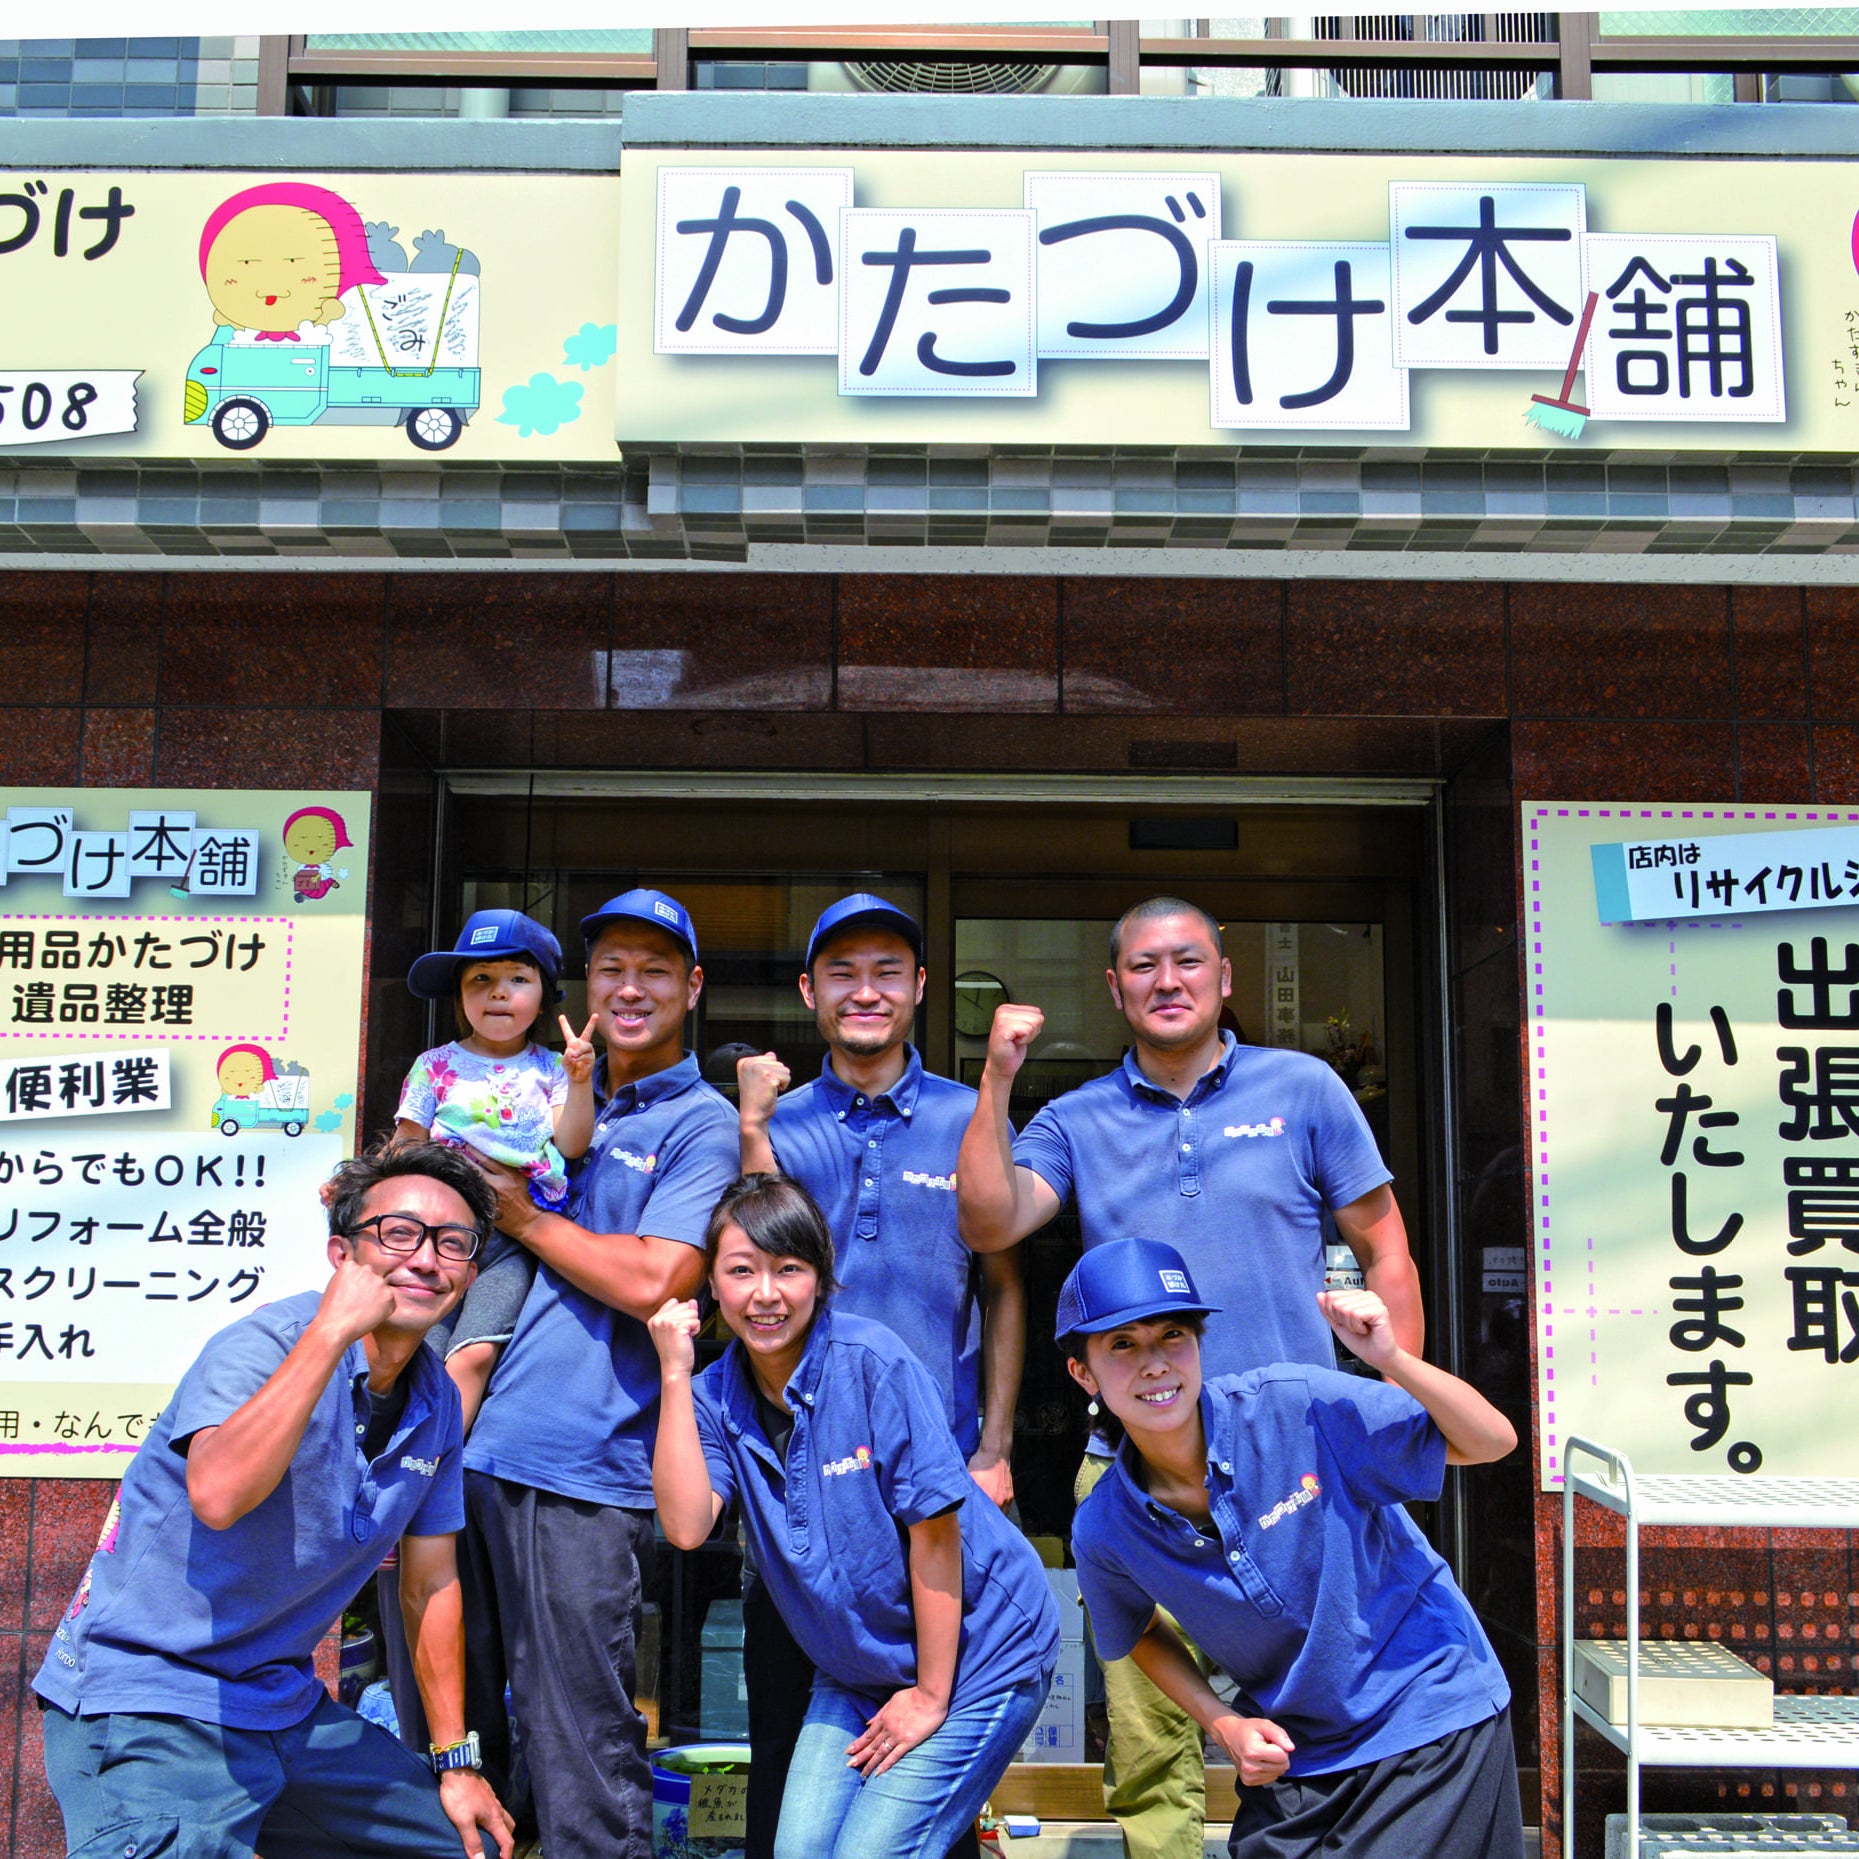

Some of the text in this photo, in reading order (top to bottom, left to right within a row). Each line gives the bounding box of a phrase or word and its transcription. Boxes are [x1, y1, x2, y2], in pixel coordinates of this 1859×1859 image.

[382, 294, 426, 352] ごみ
[675, 186, 1755, 410] かたづけ本舗
[10, 814, 250, 890] づけ本舗
[1628, 843, 1701, 869] 店内は
[0, 929, 266, 972] 用品かたづけ
[11, 981, 194, 1025] 遺品整理
[5, 1056, 159, 1114] 便利業
[1776, 936, 1859, 1364] 出張買取
[1655, 1002, 1763, 1474] いたします。
